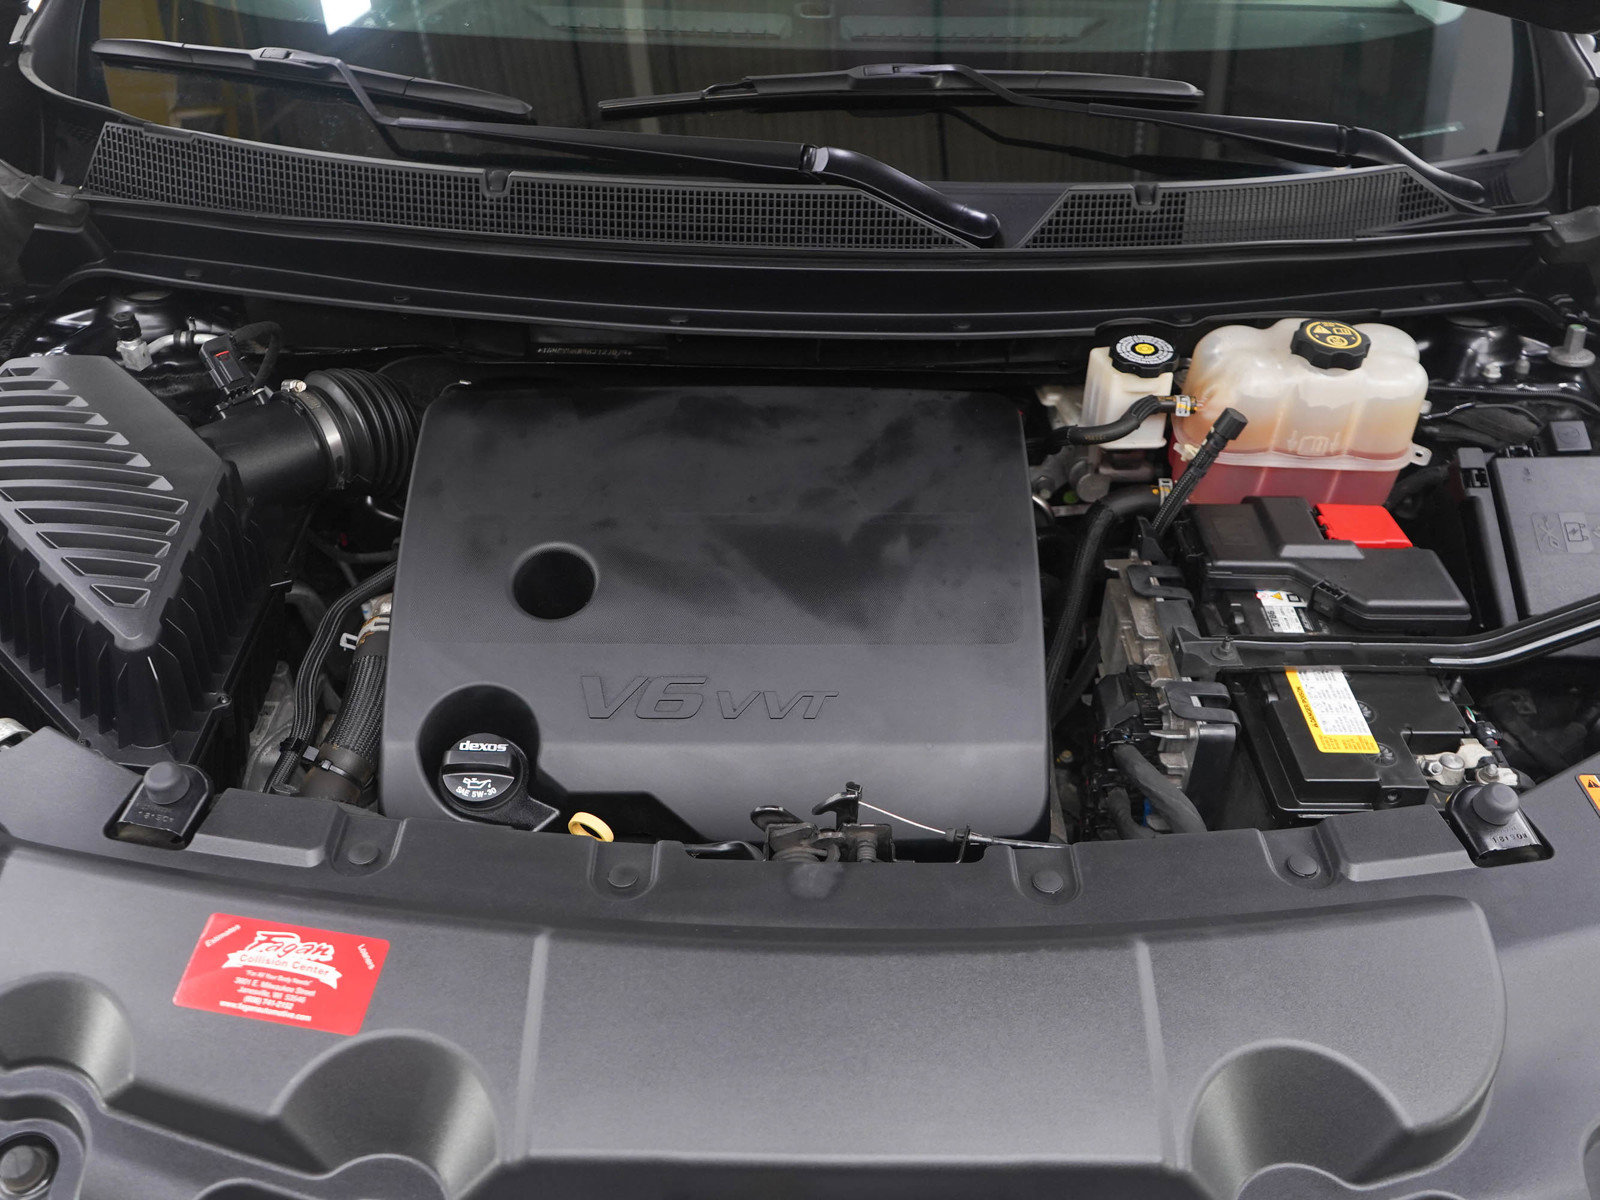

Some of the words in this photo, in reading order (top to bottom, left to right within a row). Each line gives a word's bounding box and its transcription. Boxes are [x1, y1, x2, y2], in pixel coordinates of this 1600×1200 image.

[582, 675, 709, 720] V6
[716, 690, 840, 720] VVT
[458, 740, 509, 752] dexos
[455, 786, 471, 797] SAE
[471, 787, 497, 798] 5W-30
[246, 931, 334, 961] Fagan
[239, 954, 288, 968] Collision
[291, 961, 330, 976] Center
